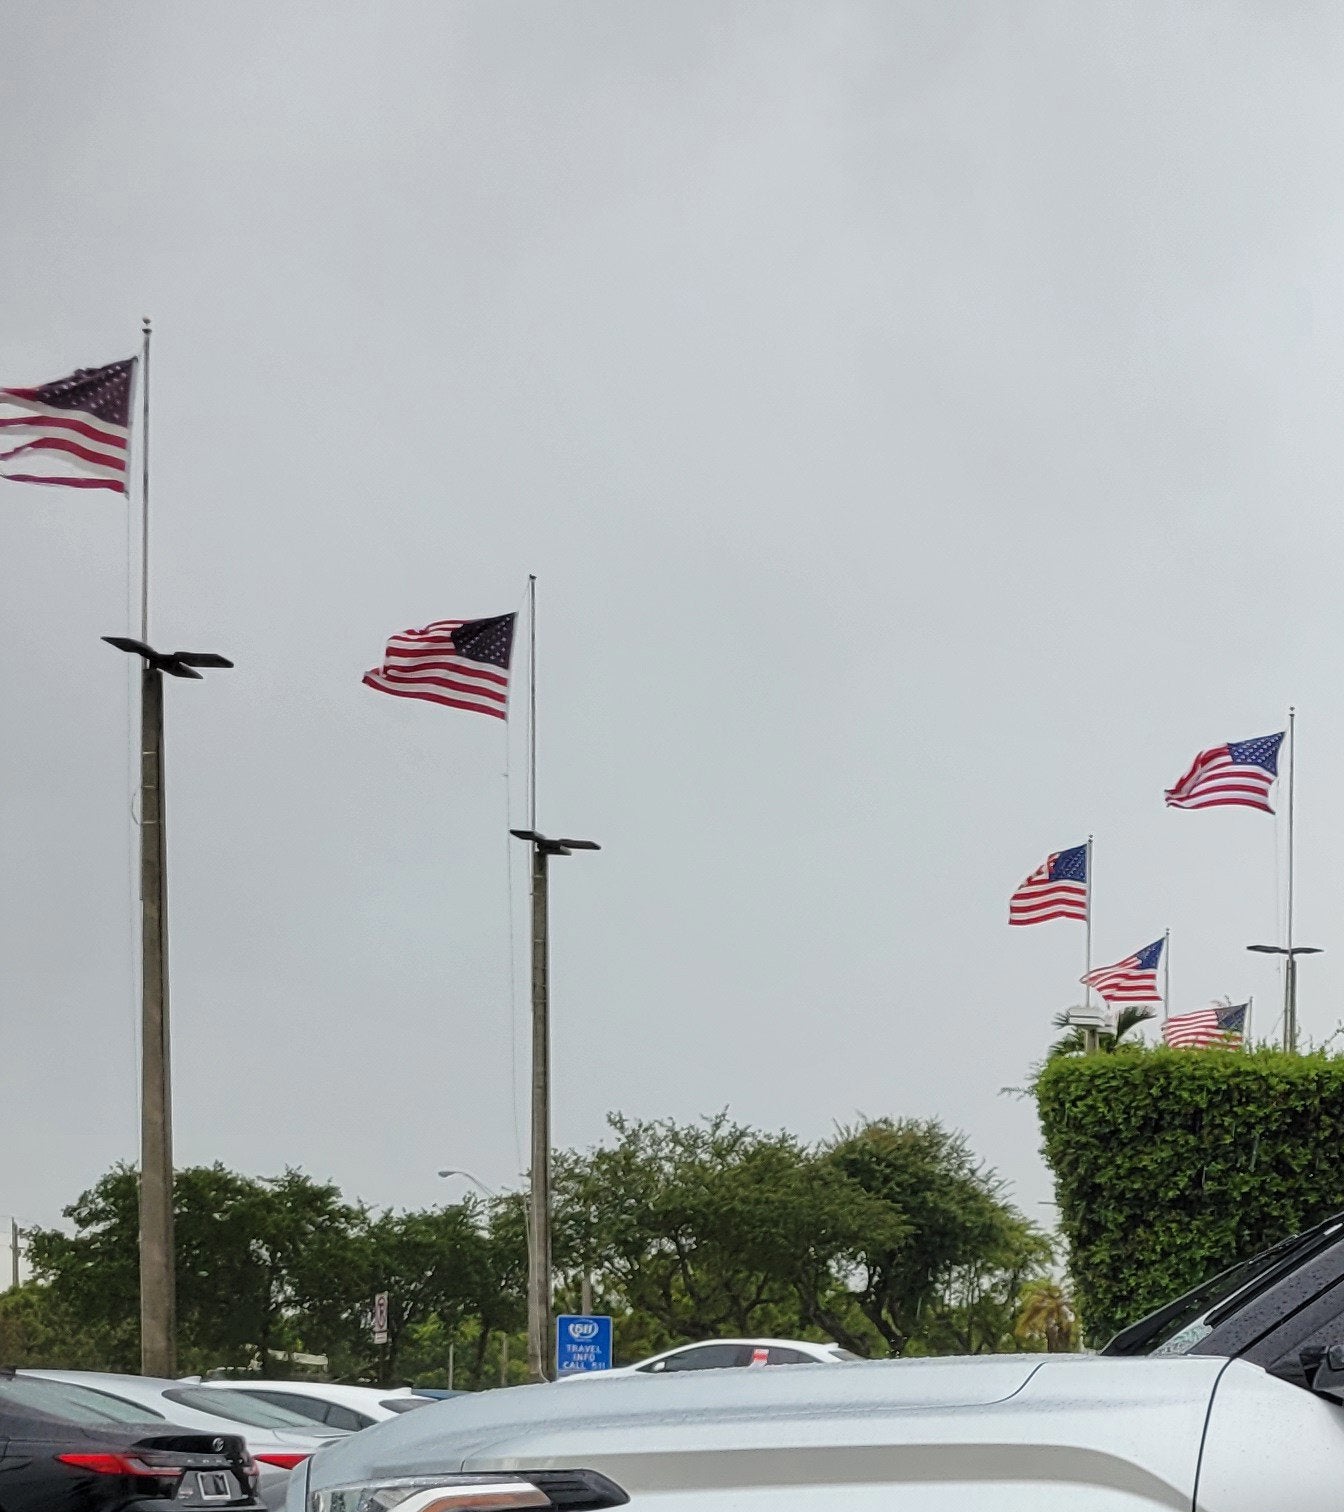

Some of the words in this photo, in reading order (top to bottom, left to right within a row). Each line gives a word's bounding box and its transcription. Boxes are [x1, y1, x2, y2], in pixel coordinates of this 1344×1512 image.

[566, 1344, 602, 1354] TRAVEL
[573, 1353, 596, 1362] INFO
[562, 1361, 586, 1370] CALL
[591, 1361, 606, 1370] 511
